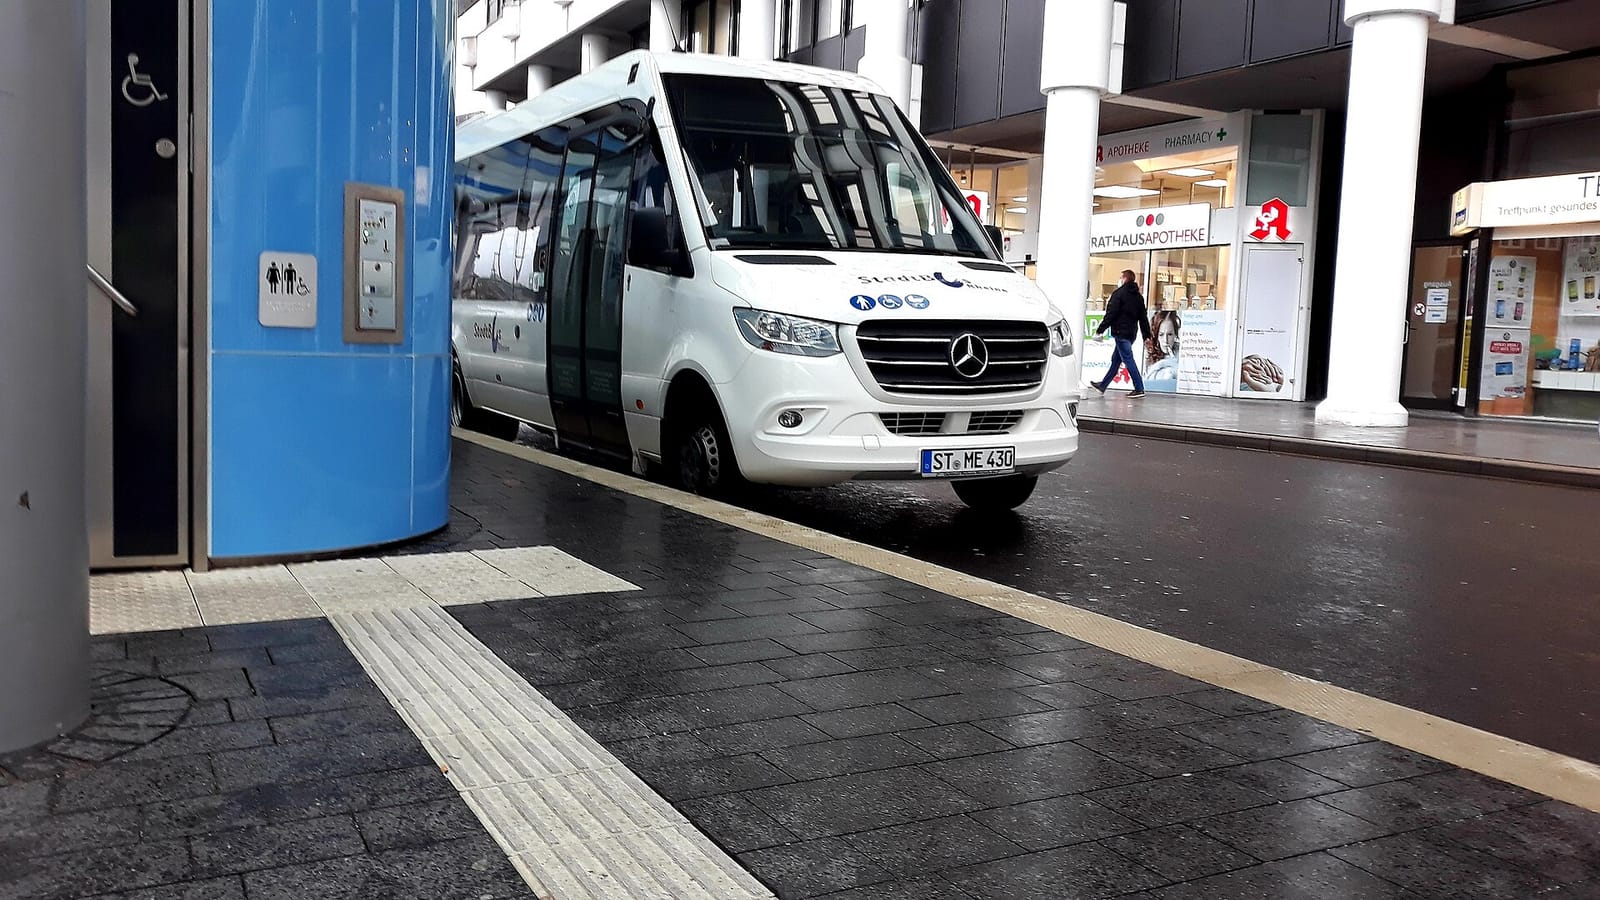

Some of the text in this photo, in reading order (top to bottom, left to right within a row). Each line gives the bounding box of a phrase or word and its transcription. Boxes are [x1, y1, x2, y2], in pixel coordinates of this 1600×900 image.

[1164, 131, 1214, 148] PHARMACY
[1107, 141, 1150, 158] APOTHEKE
[1498, 201, 1597, 217] Treffpunkt gesundes
[1090, 227, 1205, 248] RATHAUSAPOTHEKE
[932, 452, 953, 470] ST
[964, 451, 983, 469] ME
[986, 450, 1013, 467] 430
